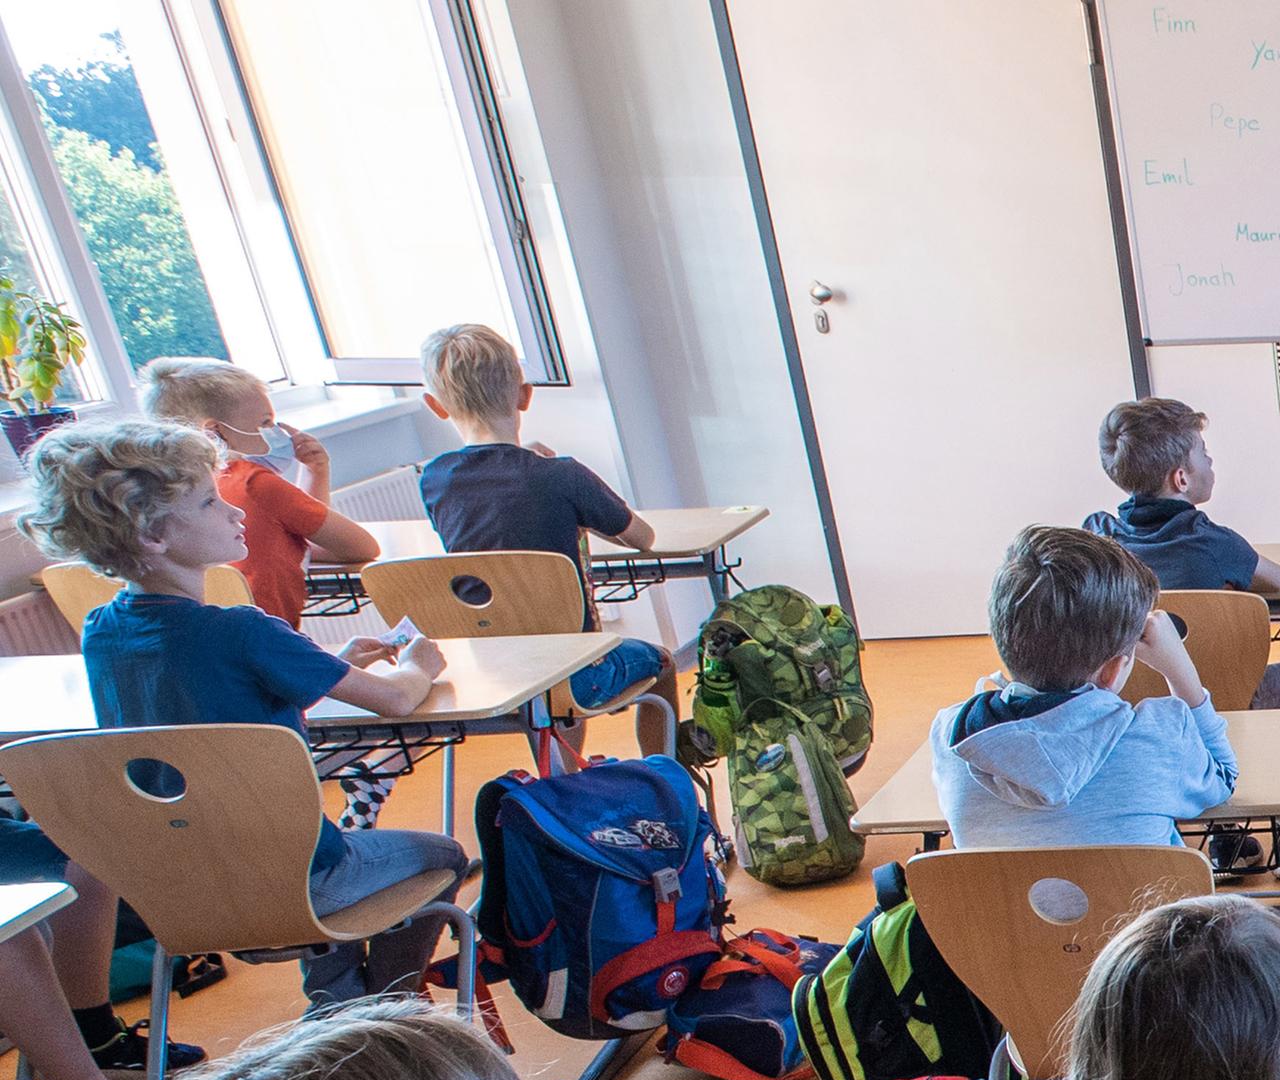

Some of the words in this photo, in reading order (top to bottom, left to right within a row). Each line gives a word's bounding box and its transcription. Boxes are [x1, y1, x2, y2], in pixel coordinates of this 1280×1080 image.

[1152, 7, 1197, 34] Finn
[1209, 103, 1262, 139] Pepe
[1144, 158, 1196, 187] Emil
